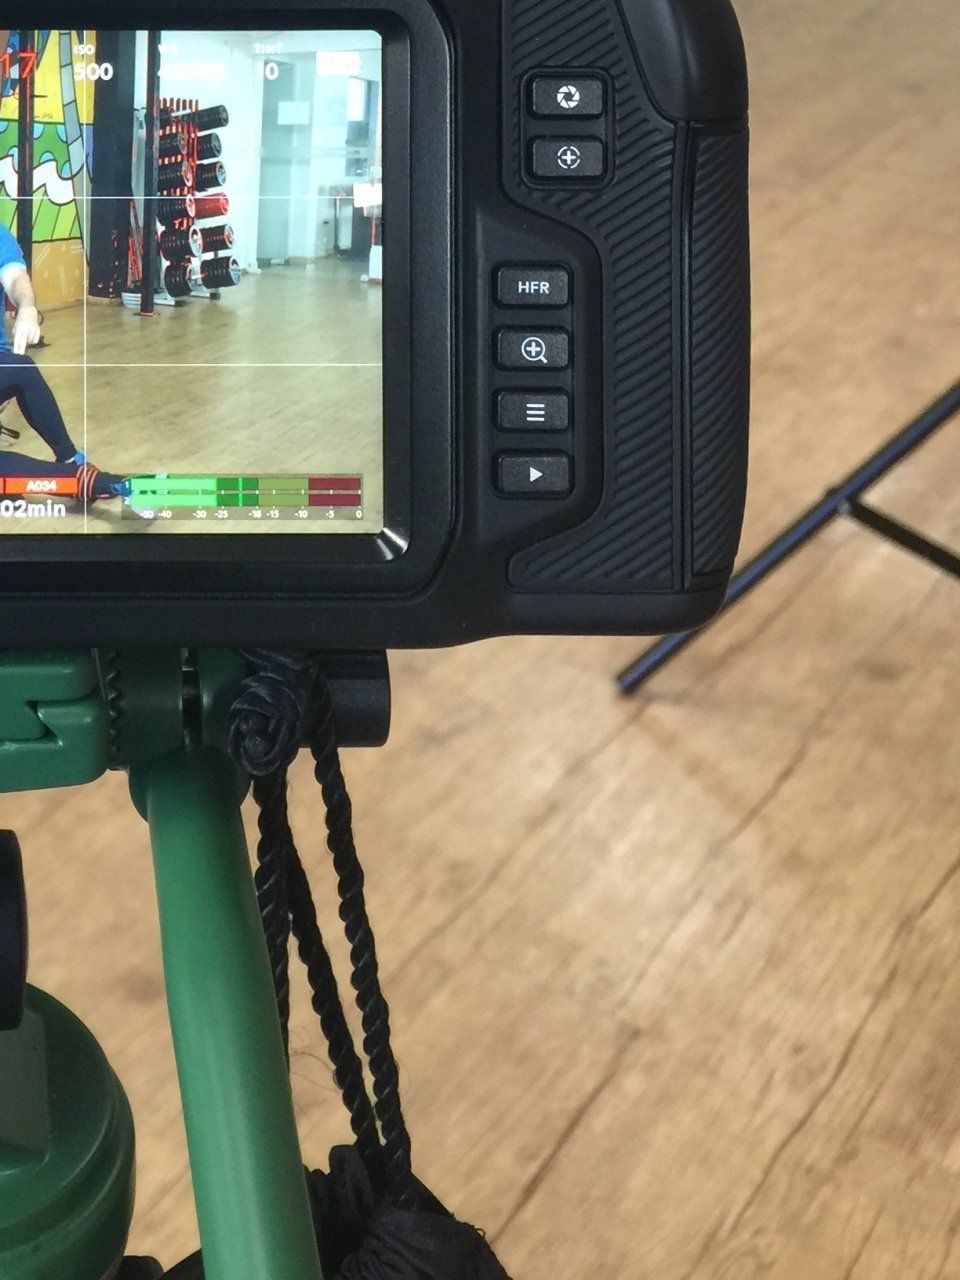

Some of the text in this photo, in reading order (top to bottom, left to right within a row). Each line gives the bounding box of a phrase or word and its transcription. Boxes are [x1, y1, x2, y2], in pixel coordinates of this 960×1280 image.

[73, 44, 95, 55] ISO
[73, 62, 114, 81] 500
[518, 281, 550, 294] HFR
